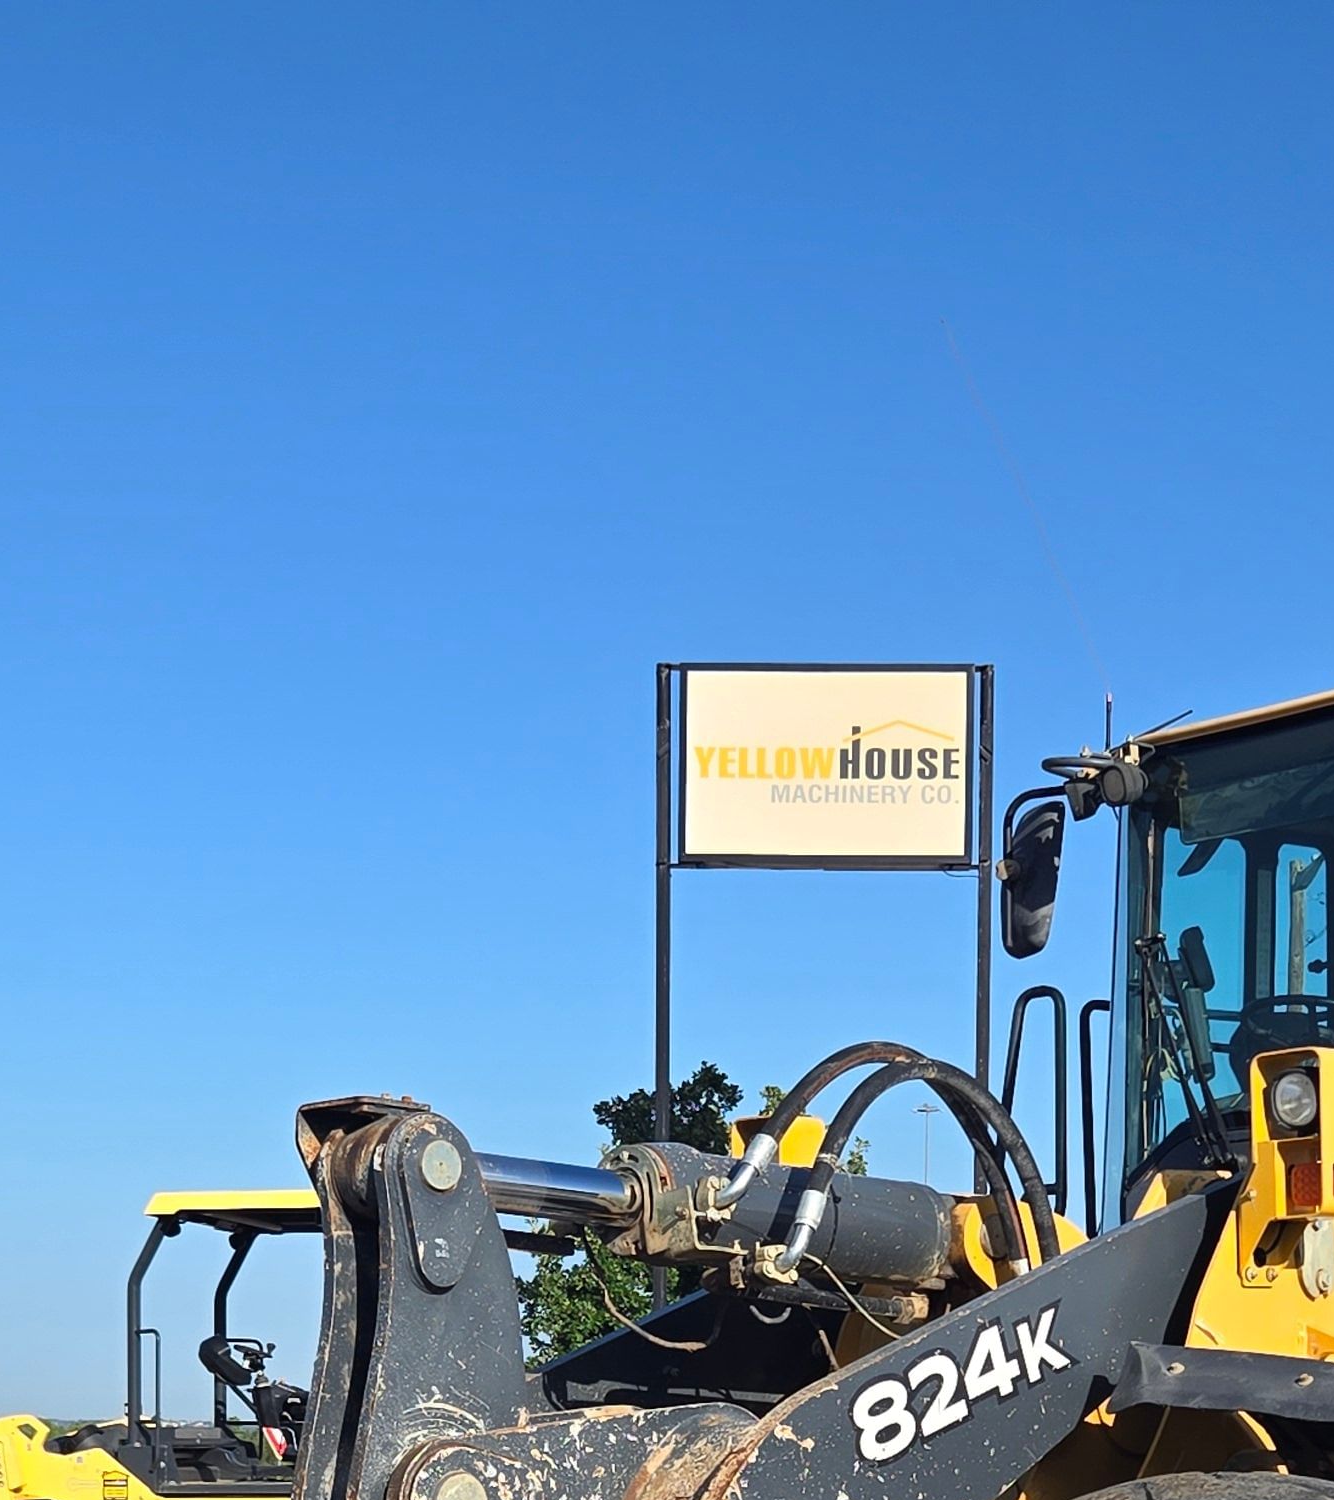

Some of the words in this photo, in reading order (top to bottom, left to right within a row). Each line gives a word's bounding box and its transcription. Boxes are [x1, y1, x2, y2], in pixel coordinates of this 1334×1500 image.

[770, 784, 912, 805] MACHINERY
[921, 784, 960, 805] CO.
[851, 1306, 1074, 1463] 824K
